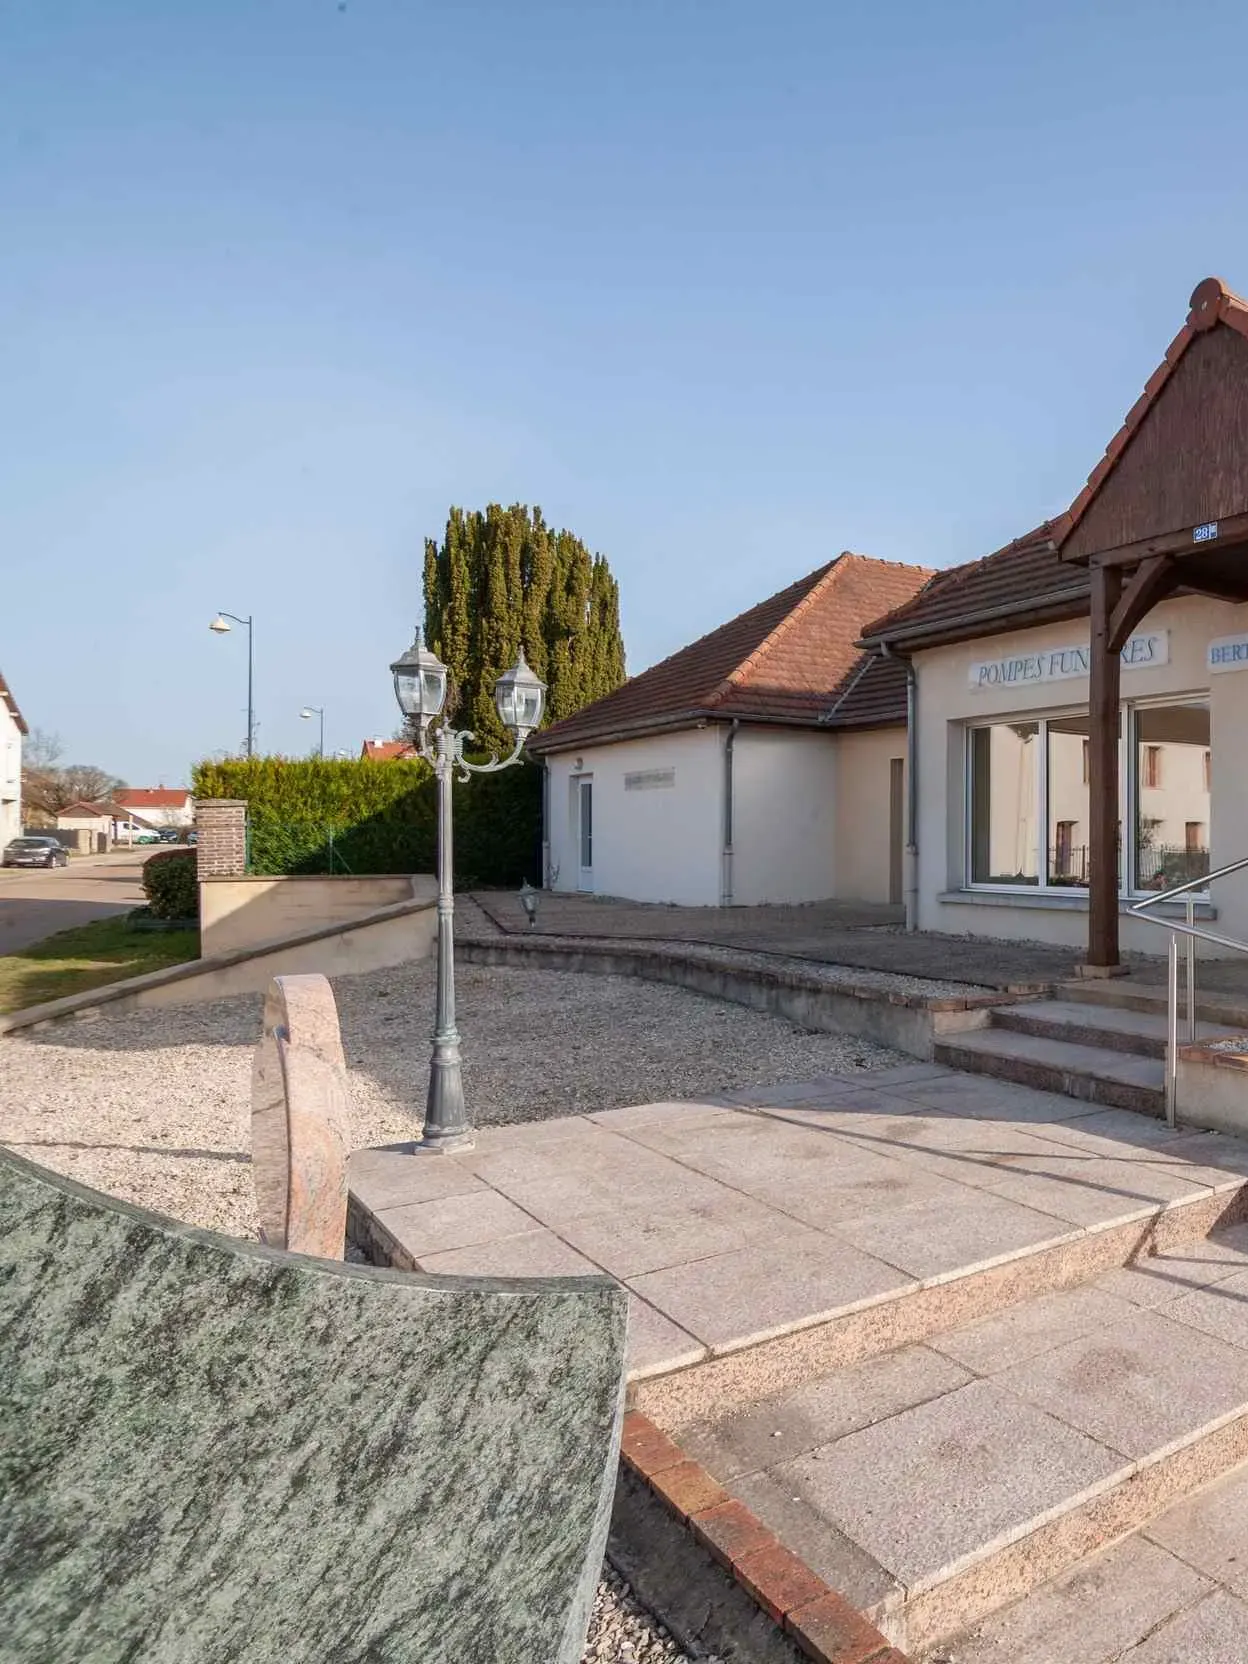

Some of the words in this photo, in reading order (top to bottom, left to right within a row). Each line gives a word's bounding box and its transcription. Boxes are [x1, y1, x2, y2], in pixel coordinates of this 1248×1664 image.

[1195, 527, 1208, 540] 28
[977, 655, 1047, 687] POMPES
[1048, 636, 1158, 676] FUNRES
